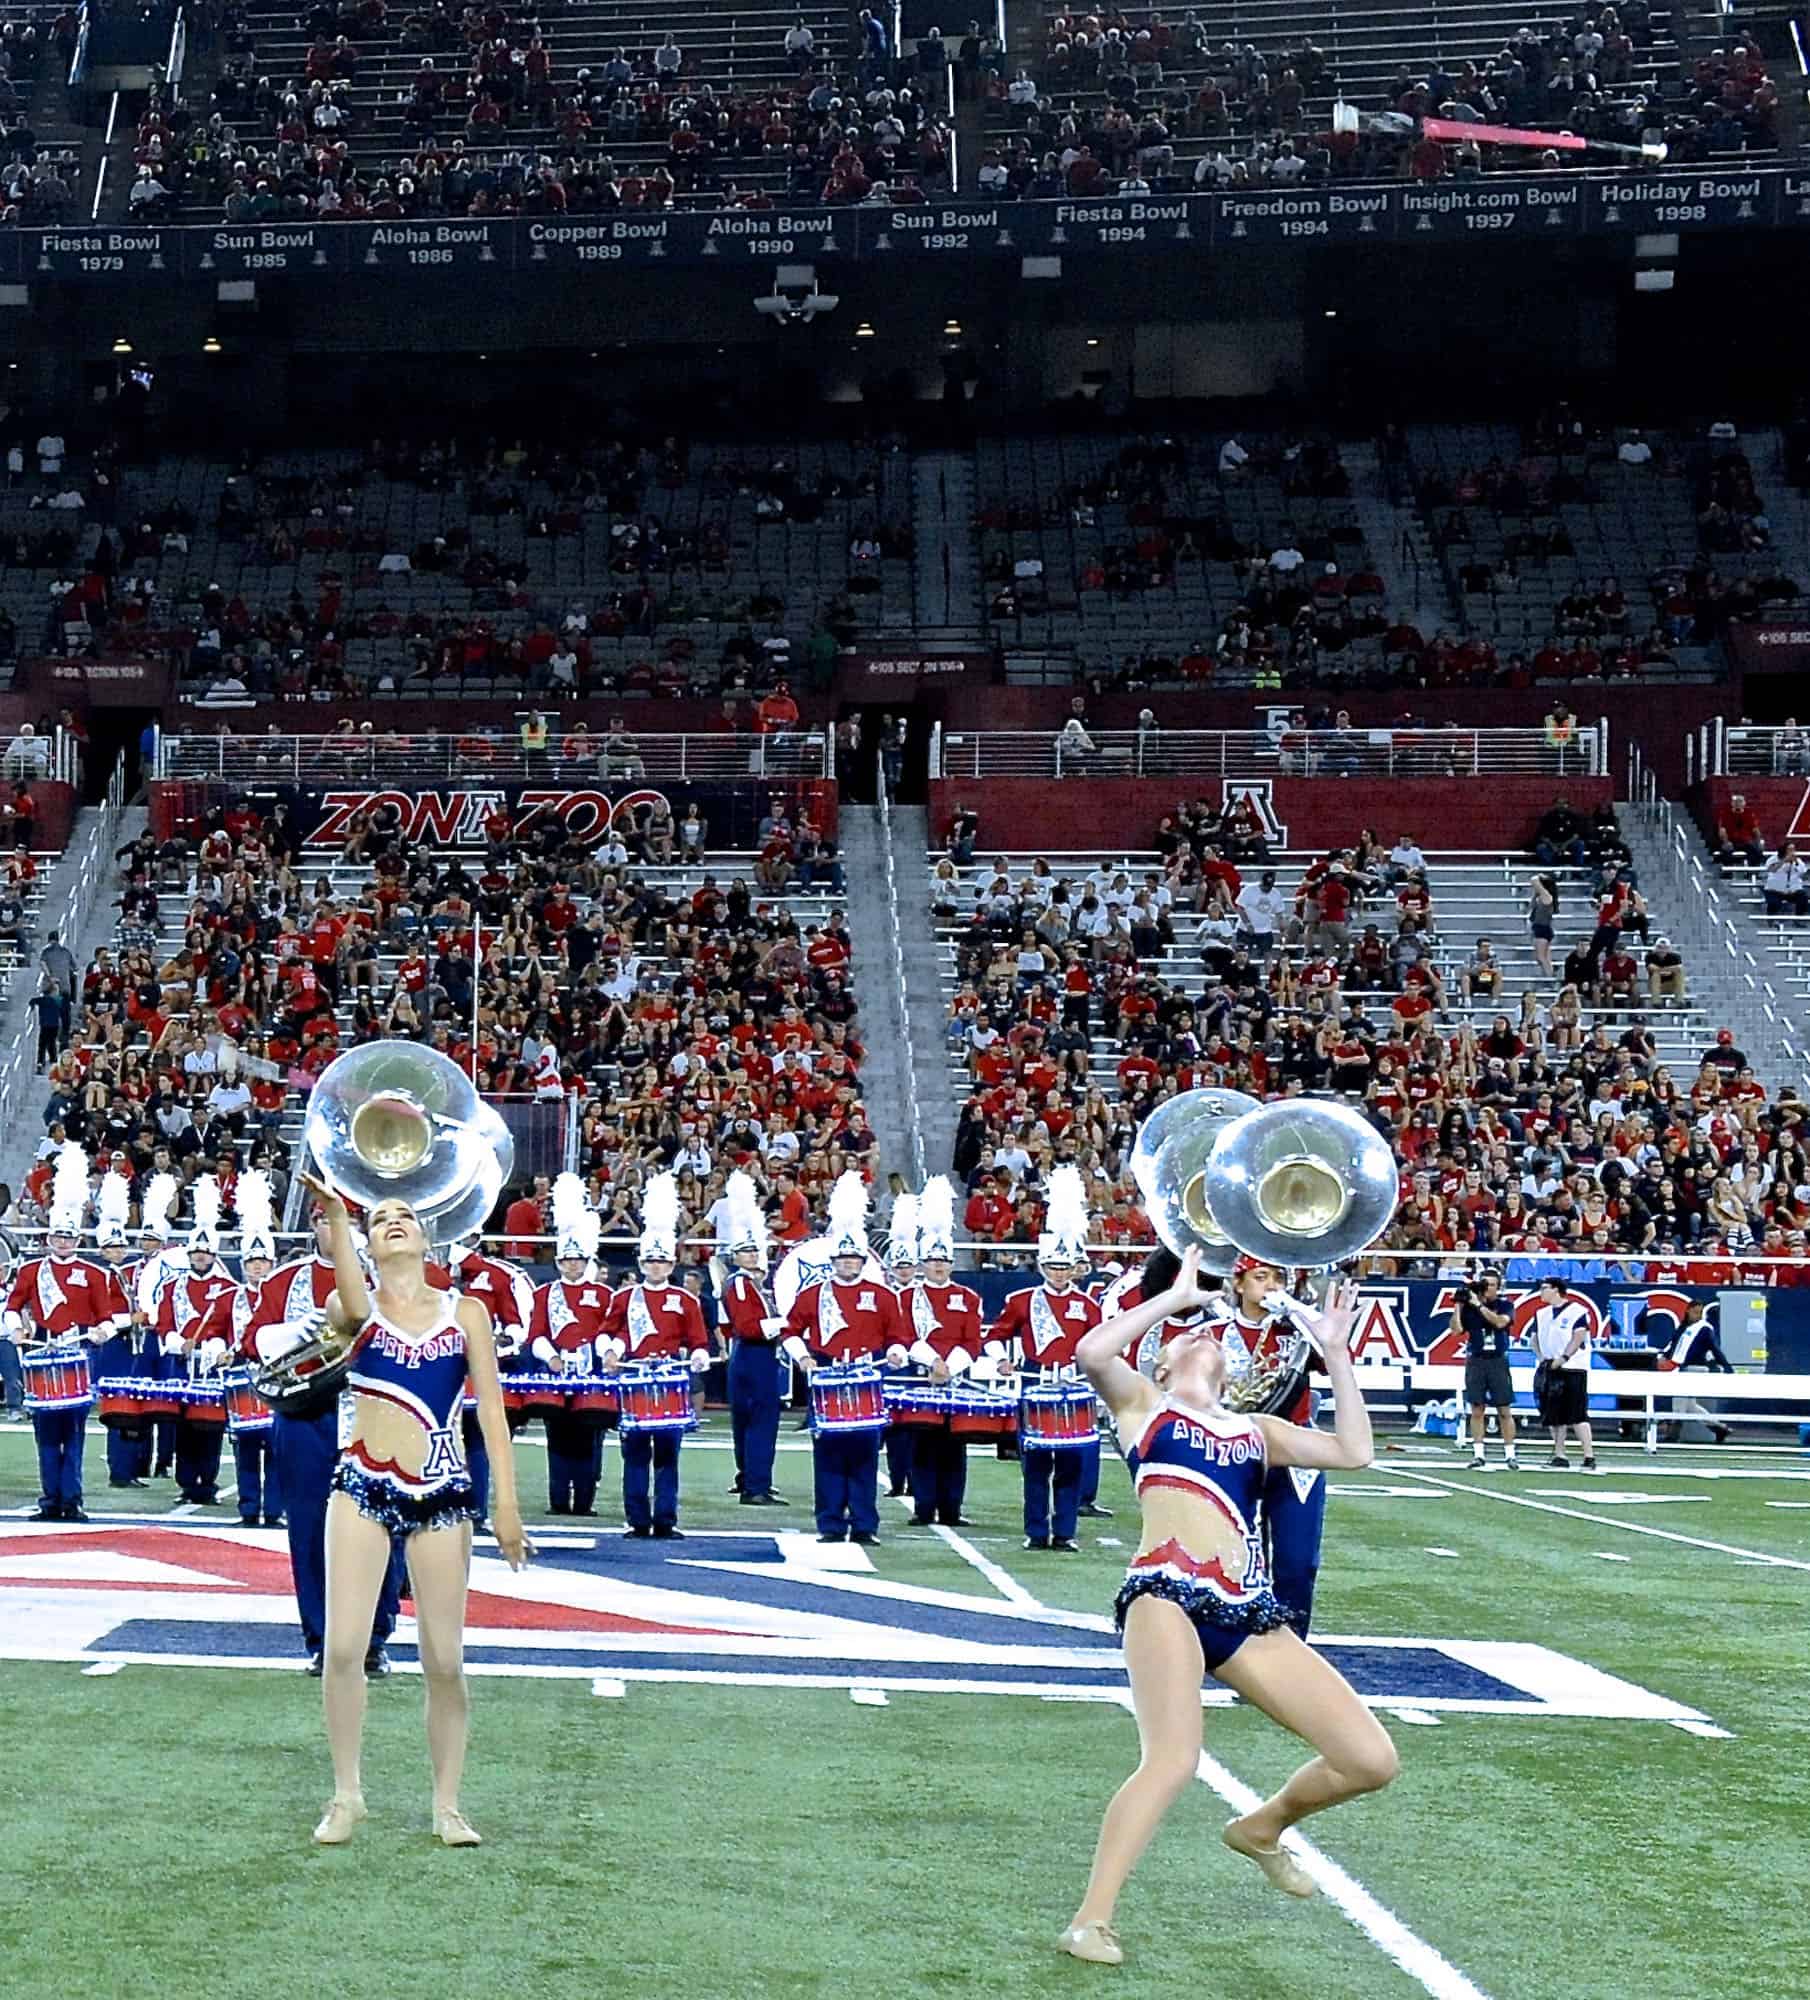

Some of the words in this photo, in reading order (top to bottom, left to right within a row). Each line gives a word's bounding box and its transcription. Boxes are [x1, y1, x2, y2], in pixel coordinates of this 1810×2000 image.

[1404, 193, 1520, 212] Insight.com
[1527, 187, 1577, 204] Bowl
[1602, 184, 1691, 203] Holiday
[1700, 179, 1760, 197] Bowl
[1056, 206, 1122, 221] Fiesta
[1131, 202, 1188, 218] Bowl
[1222, 200, 1320, 216] Freedom
[1329, 195, 1387, 212] Bowl
[1654, 205, 1706, 220] 1998
[708, 218, 770, 235] Aloha
[778, 215, 833, 232] Bowl
[892, 213, 929, 229] Sun
[943, 210, 997, 228] Bowl
[1279, 221, 1328, 235] 1994
[1465, 214, 1514, 228] 1997
[214, 233, 248, 249] Sun
[256, 230, 313, 248] Bowl
[372, 228, 430, 244] Aloha
[437, 226, 489, 243] Bowl
[529, 224, 606, 243] Copper
[613, 221, 667, 238] Bowl
[1098, 228, 1146, 242] 1994
[42, 235, 101, 252] Fiesta
[109, 234, 160, 250] Bowl
[747, 240, 794, 254] 1990
[920, 234, 968, 249] 1992
[407, 250, 453, 264] 1986
[576, 245, 622, 259] 1989
[79, 257, 124, 271] 1979
[242, 255, 286, 268] 1985
[422, 1428, 465, 1479] A
